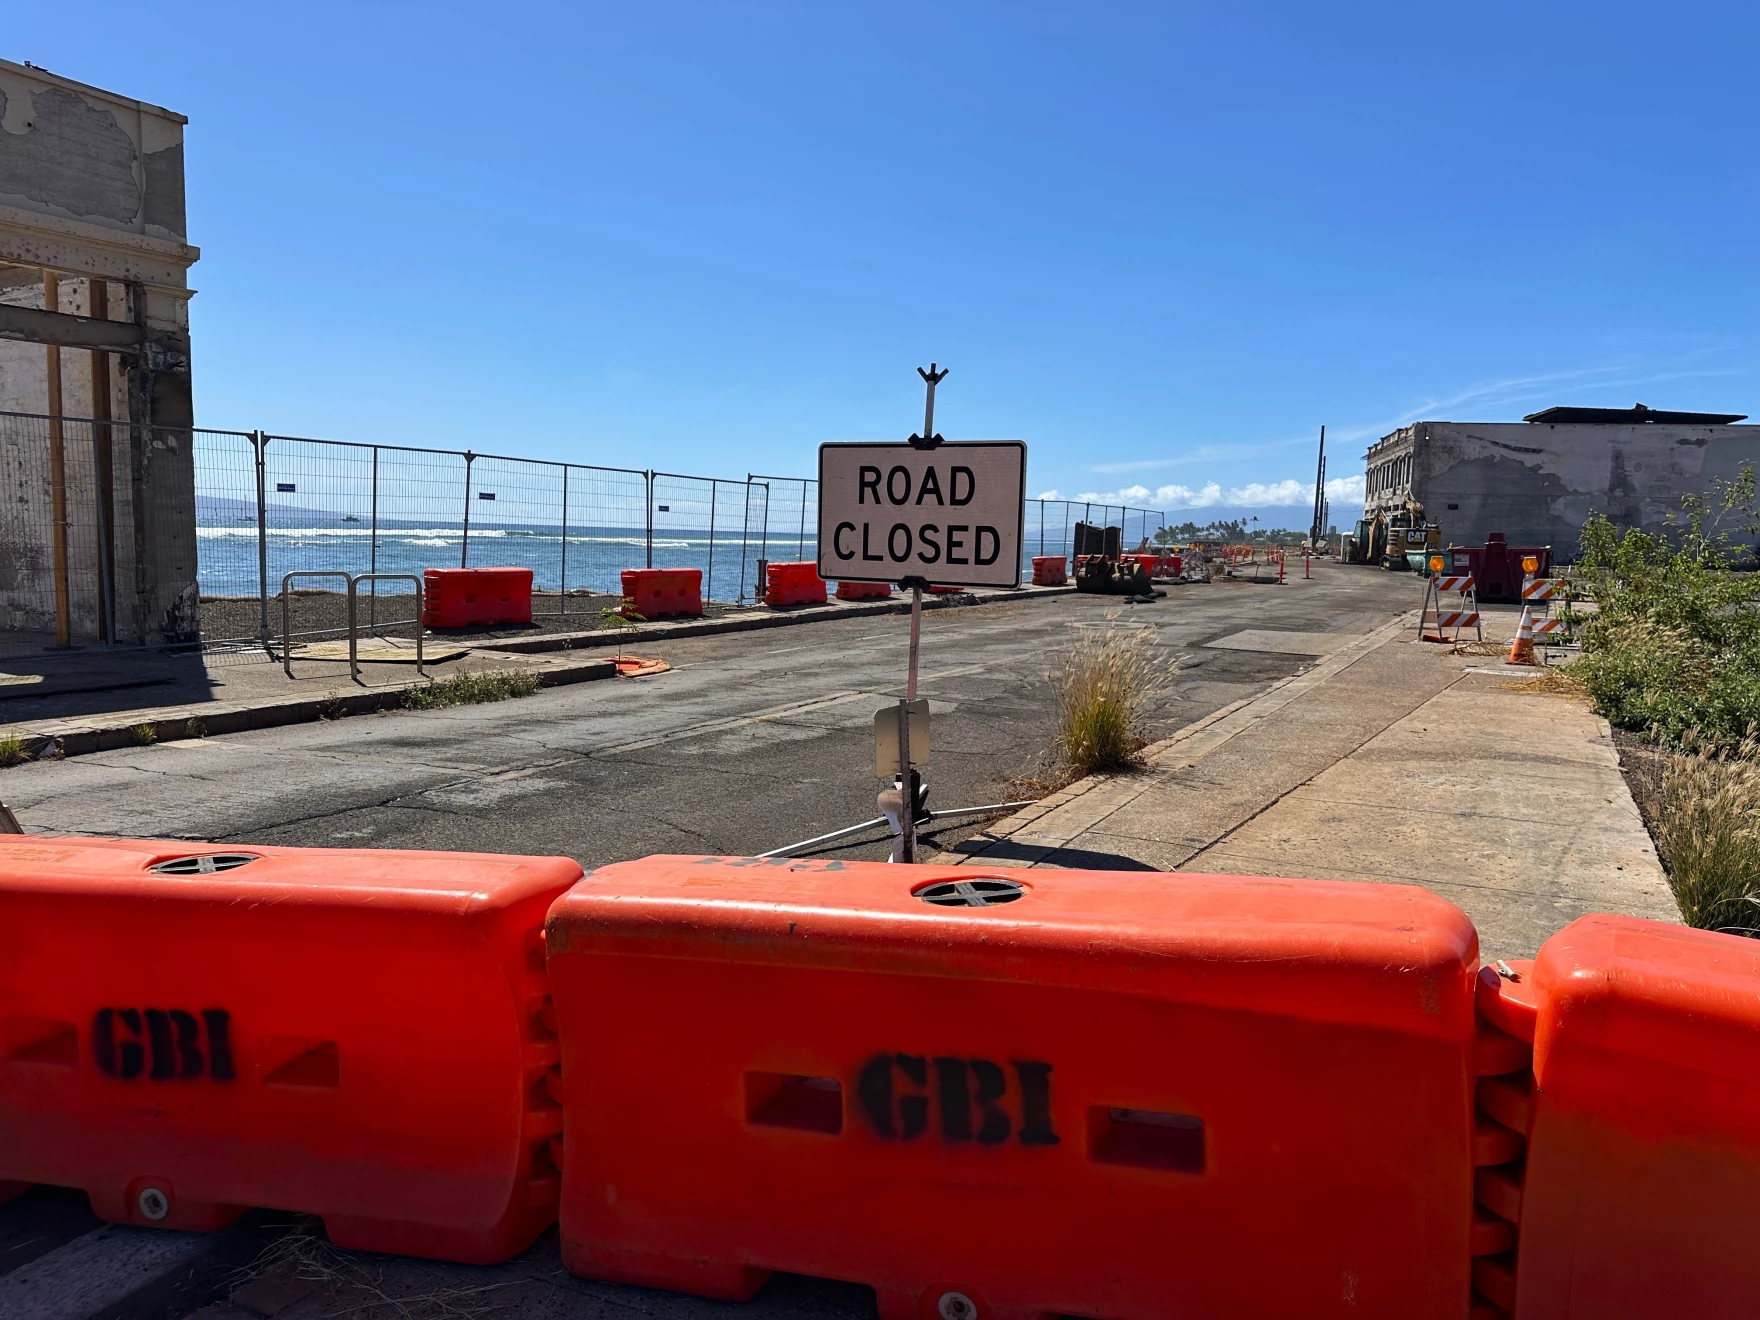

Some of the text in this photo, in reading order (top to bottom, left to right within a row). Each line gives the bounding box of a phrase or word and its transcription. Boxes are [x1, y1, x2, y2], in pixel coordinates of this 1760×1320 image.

[858, 465, 975, 506] ROAD
[833, 521, 1000, 566] CLOSED
[1407, 531, 1426, 542] CAT
[93, 1007, 237, 1082] GBI
[858, 1052, 1060, 1145] GBI
